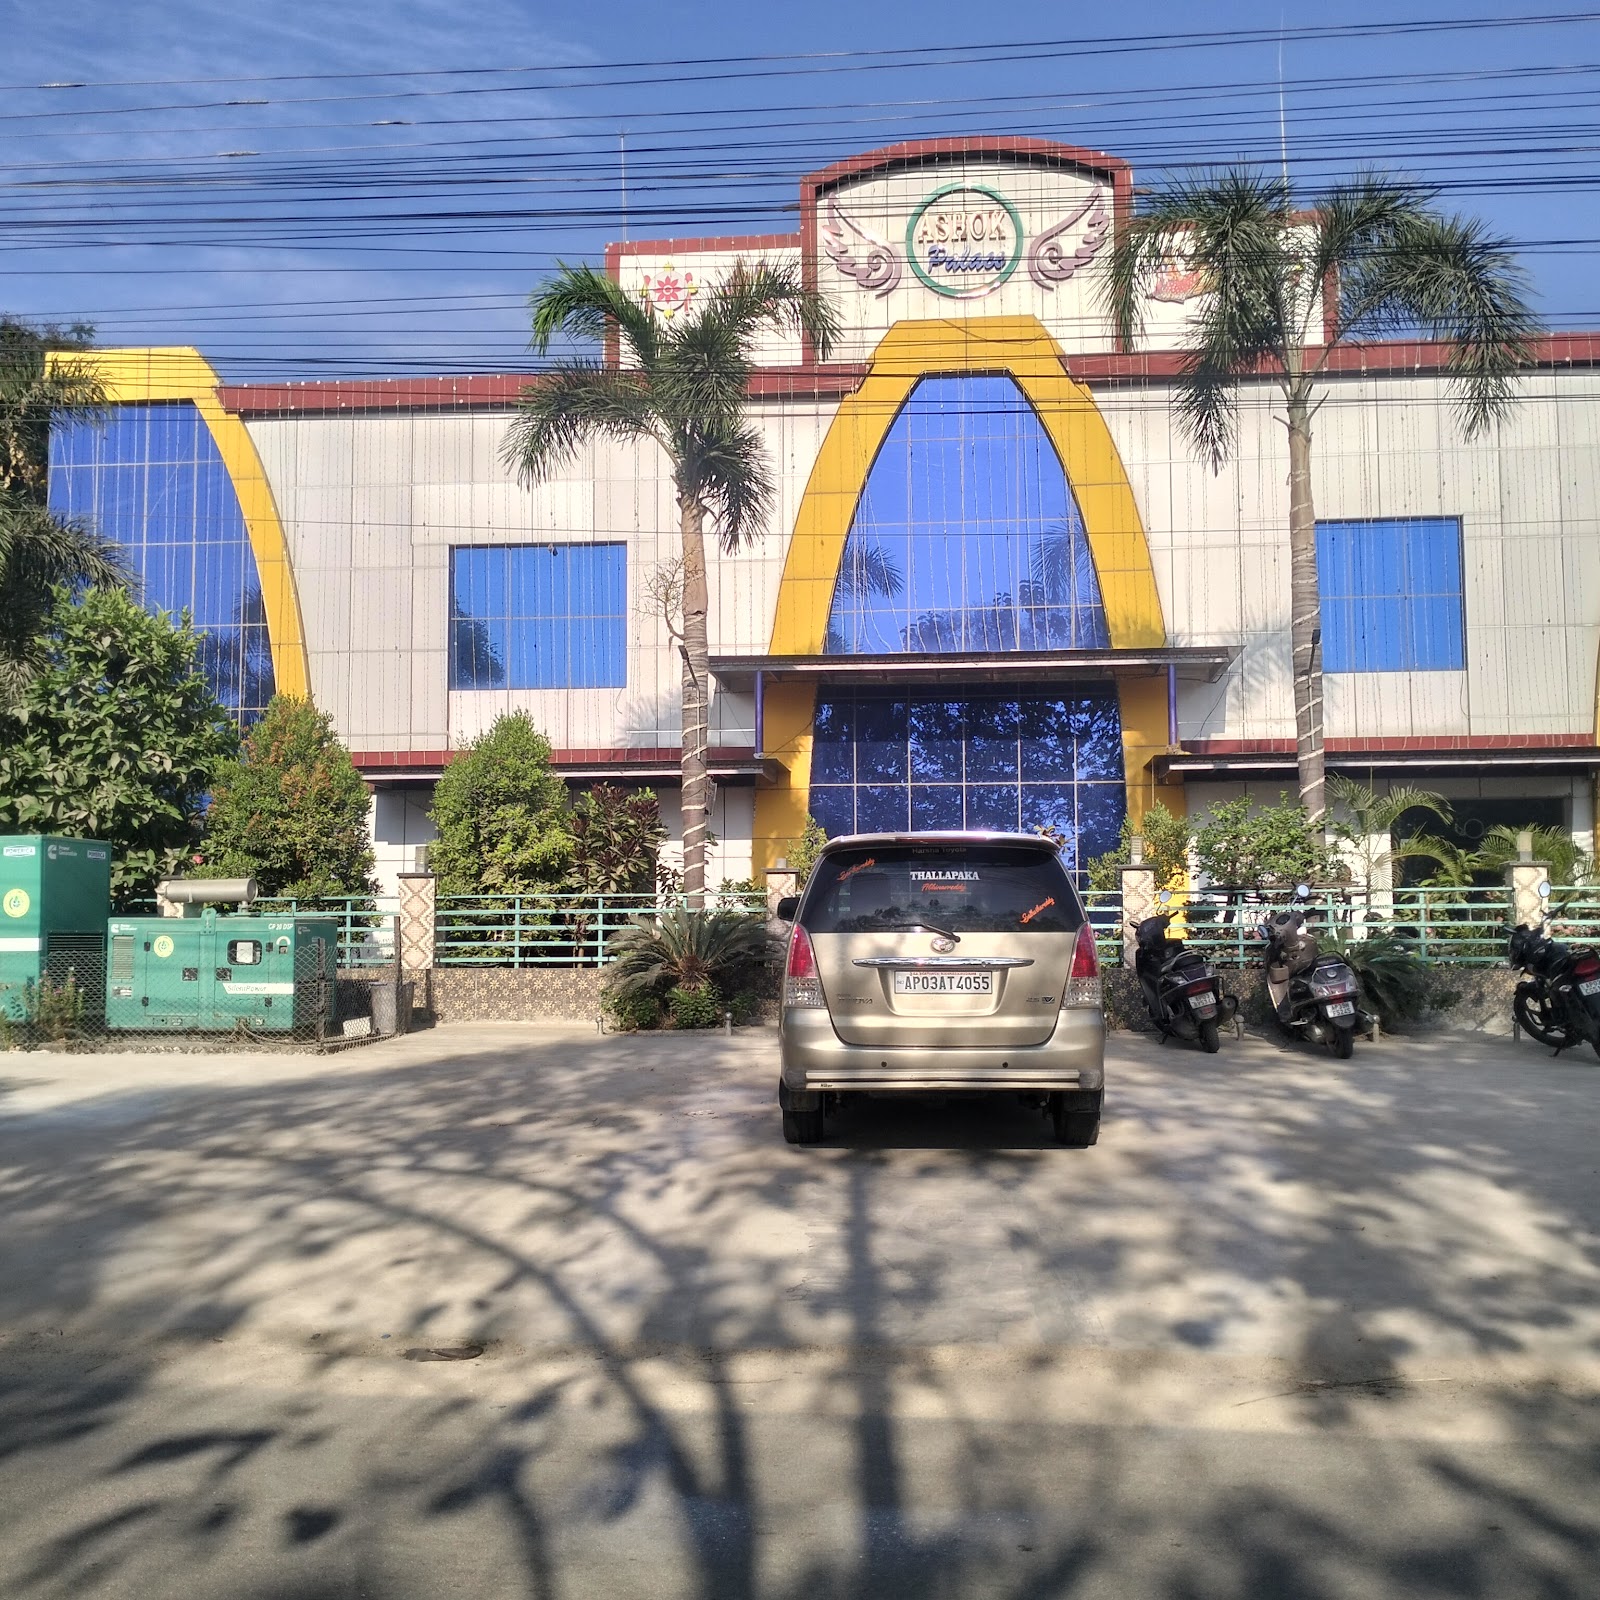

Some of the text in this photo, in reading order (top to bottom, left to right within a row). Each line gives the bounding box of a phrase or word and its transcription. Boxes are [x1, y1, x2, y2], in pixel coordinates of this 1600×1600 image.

[918, 210, 1007, 244] ASHOK
[927, 244, 1007, 275] Palace
[942, 846, 967, 855] Toyota
[910, 871, 981, 880] THALLAPAKA
[905, 975, 990, 990] AP03AT4055
